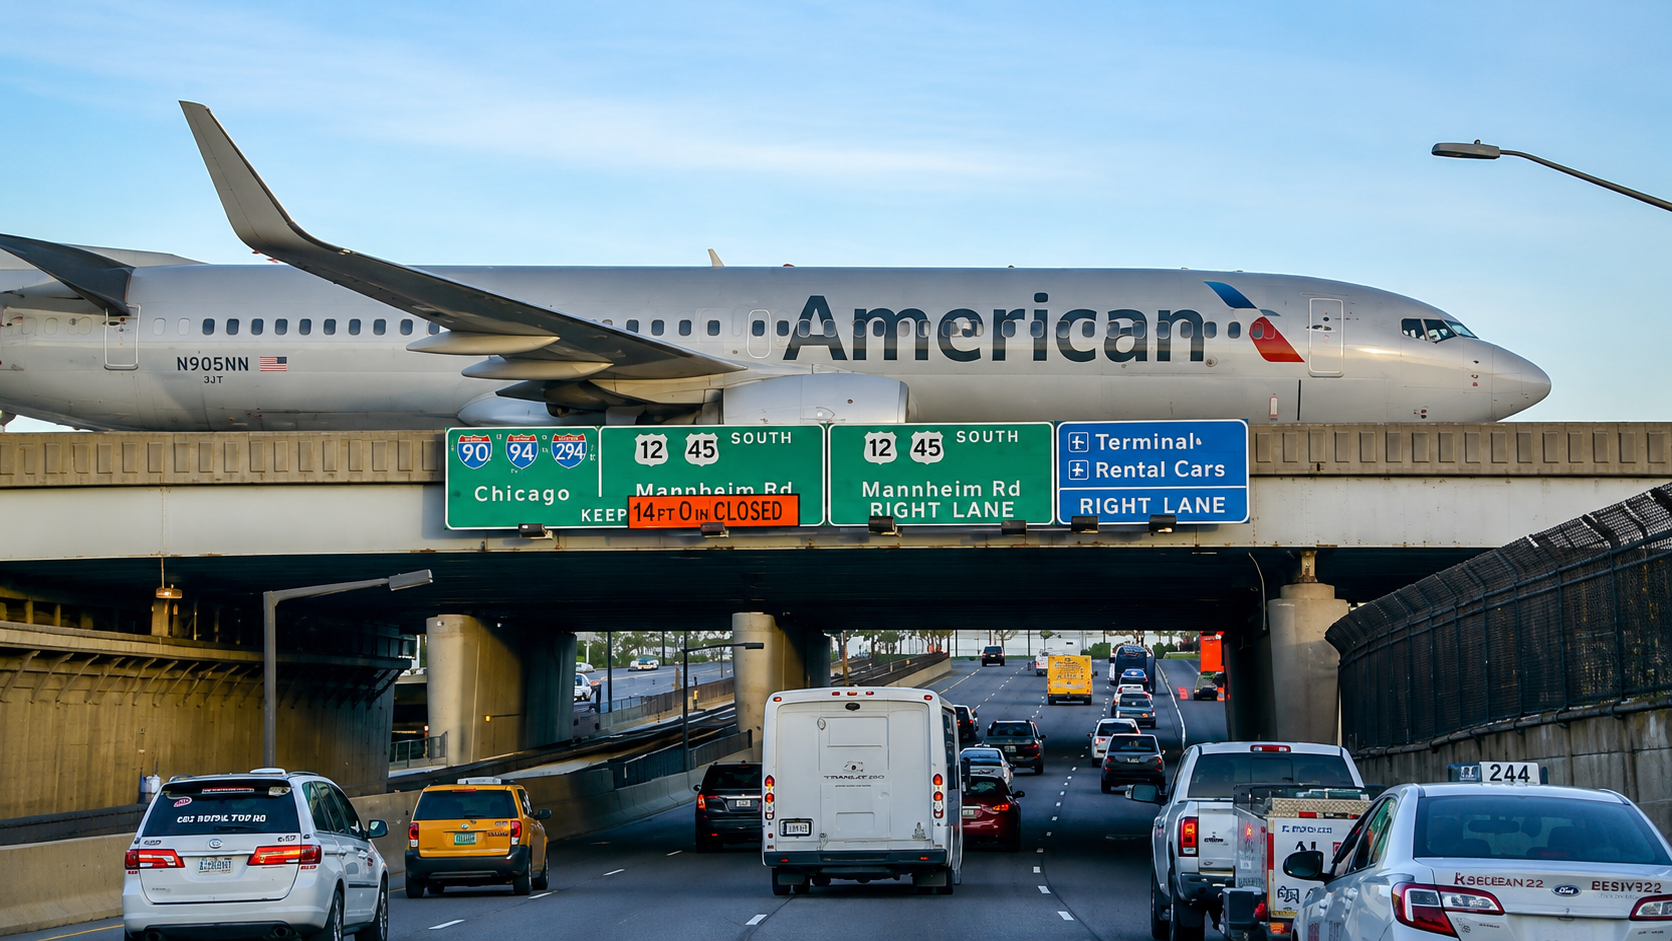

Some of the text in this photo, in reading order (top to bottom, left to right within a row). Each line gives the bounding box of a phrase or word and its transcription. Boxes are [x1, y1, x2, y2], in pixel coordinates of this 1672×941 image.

[783, 293, 1205, 362] American
[177, 356, 249, 371] N905NN
[731, 431, 792, 444] SOUTH
[956, 430, 1019, 443] SOUTH
[462, 443, 489, 462] 90
[509, 443, 534, 462] 94
[555, 443, 585, 461] 294
[640, 440, 663, 459] 12
[687, 440, 716, 459] 45
[869, 438, 892, 457] 12
[913, 438, 941, 457] 45
[1096, 460, 1226, 478] Rental Cars
[474, 485, 570, 506] Chicago
[862, 480, 1021, 498] Mannheim Rd
[714, 500, 782, 521] CLOSED
[870, 501, 1014, 518] RIGHT LANE
[1080, 496, 1226, 515] RIGHT LANE
[581, 509, 627, 522] KEEP
[1489, 763, 1530, 782] 244
